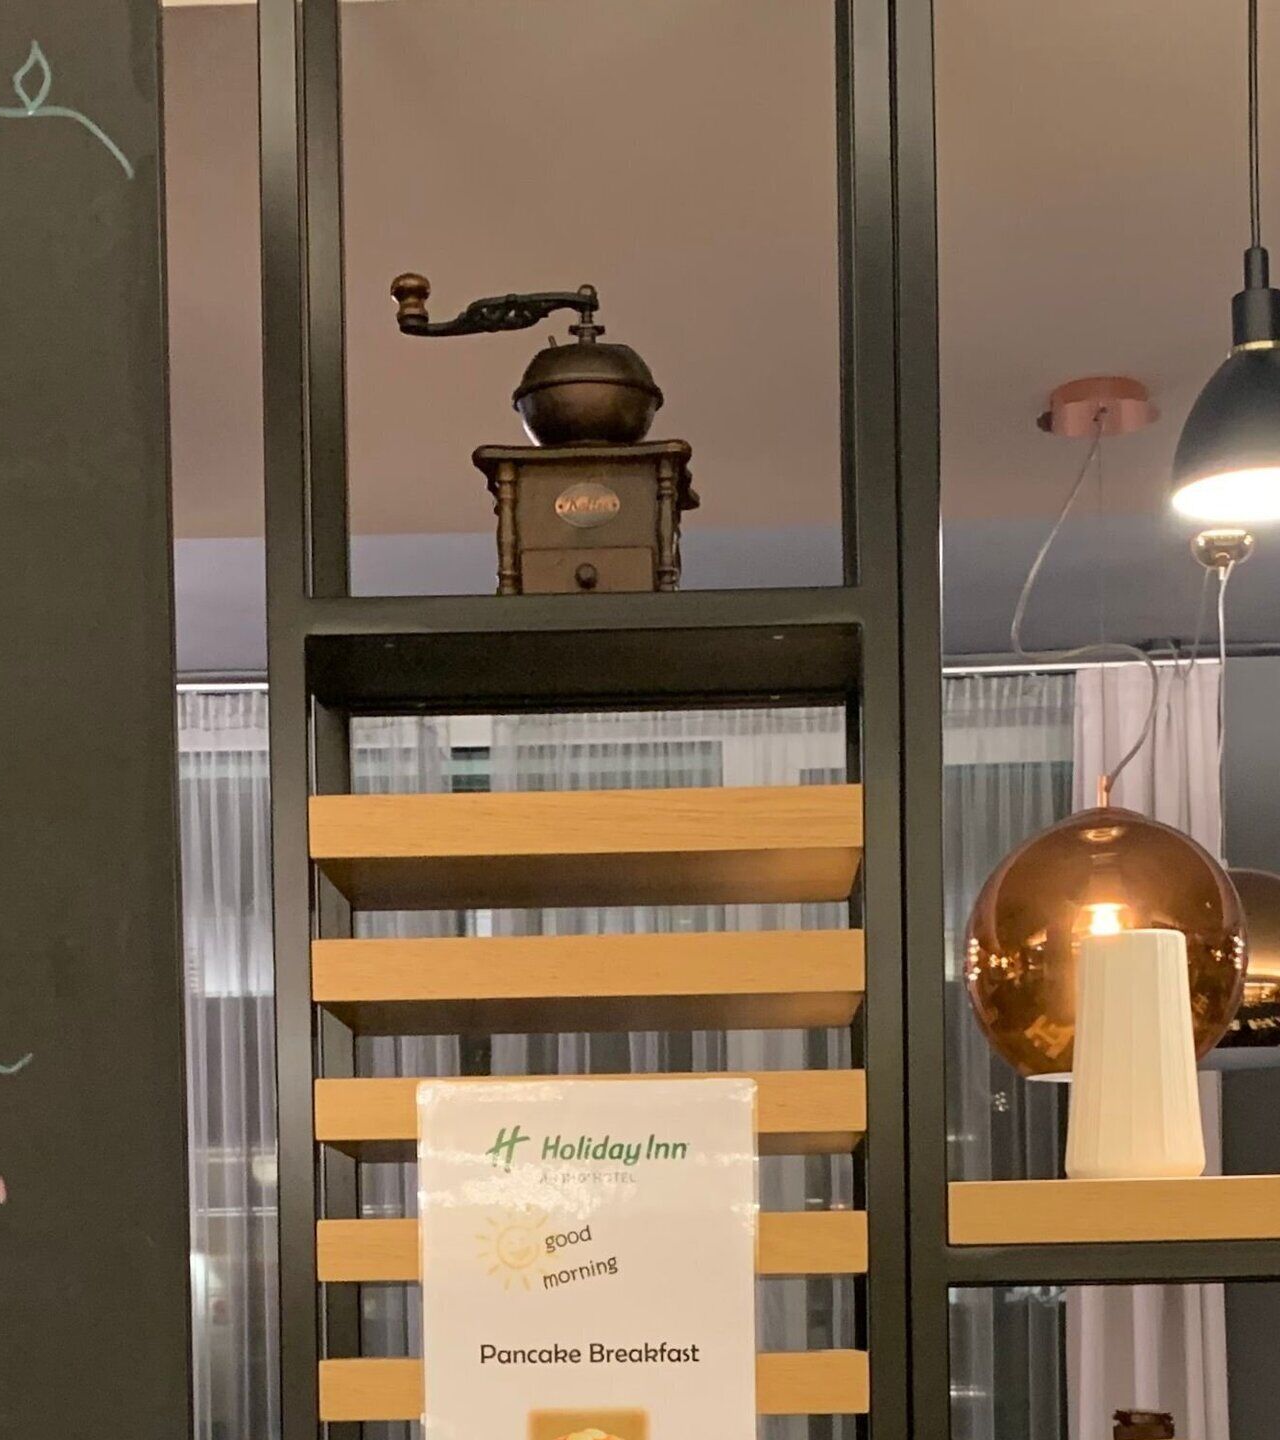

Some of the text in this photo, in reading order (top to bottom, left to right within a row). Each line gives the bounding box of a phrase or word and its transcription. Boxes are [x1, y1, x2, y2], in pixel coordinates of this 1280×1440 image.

[541, 1134, 642, 1166] Holiday
[646, 1133, 689, 1160] Inn
[545, 1224, 592, 1254] good
[542, 1256, 618, 1290] morning
[479, 1341, 700, 1365] Pancake Breakfast
